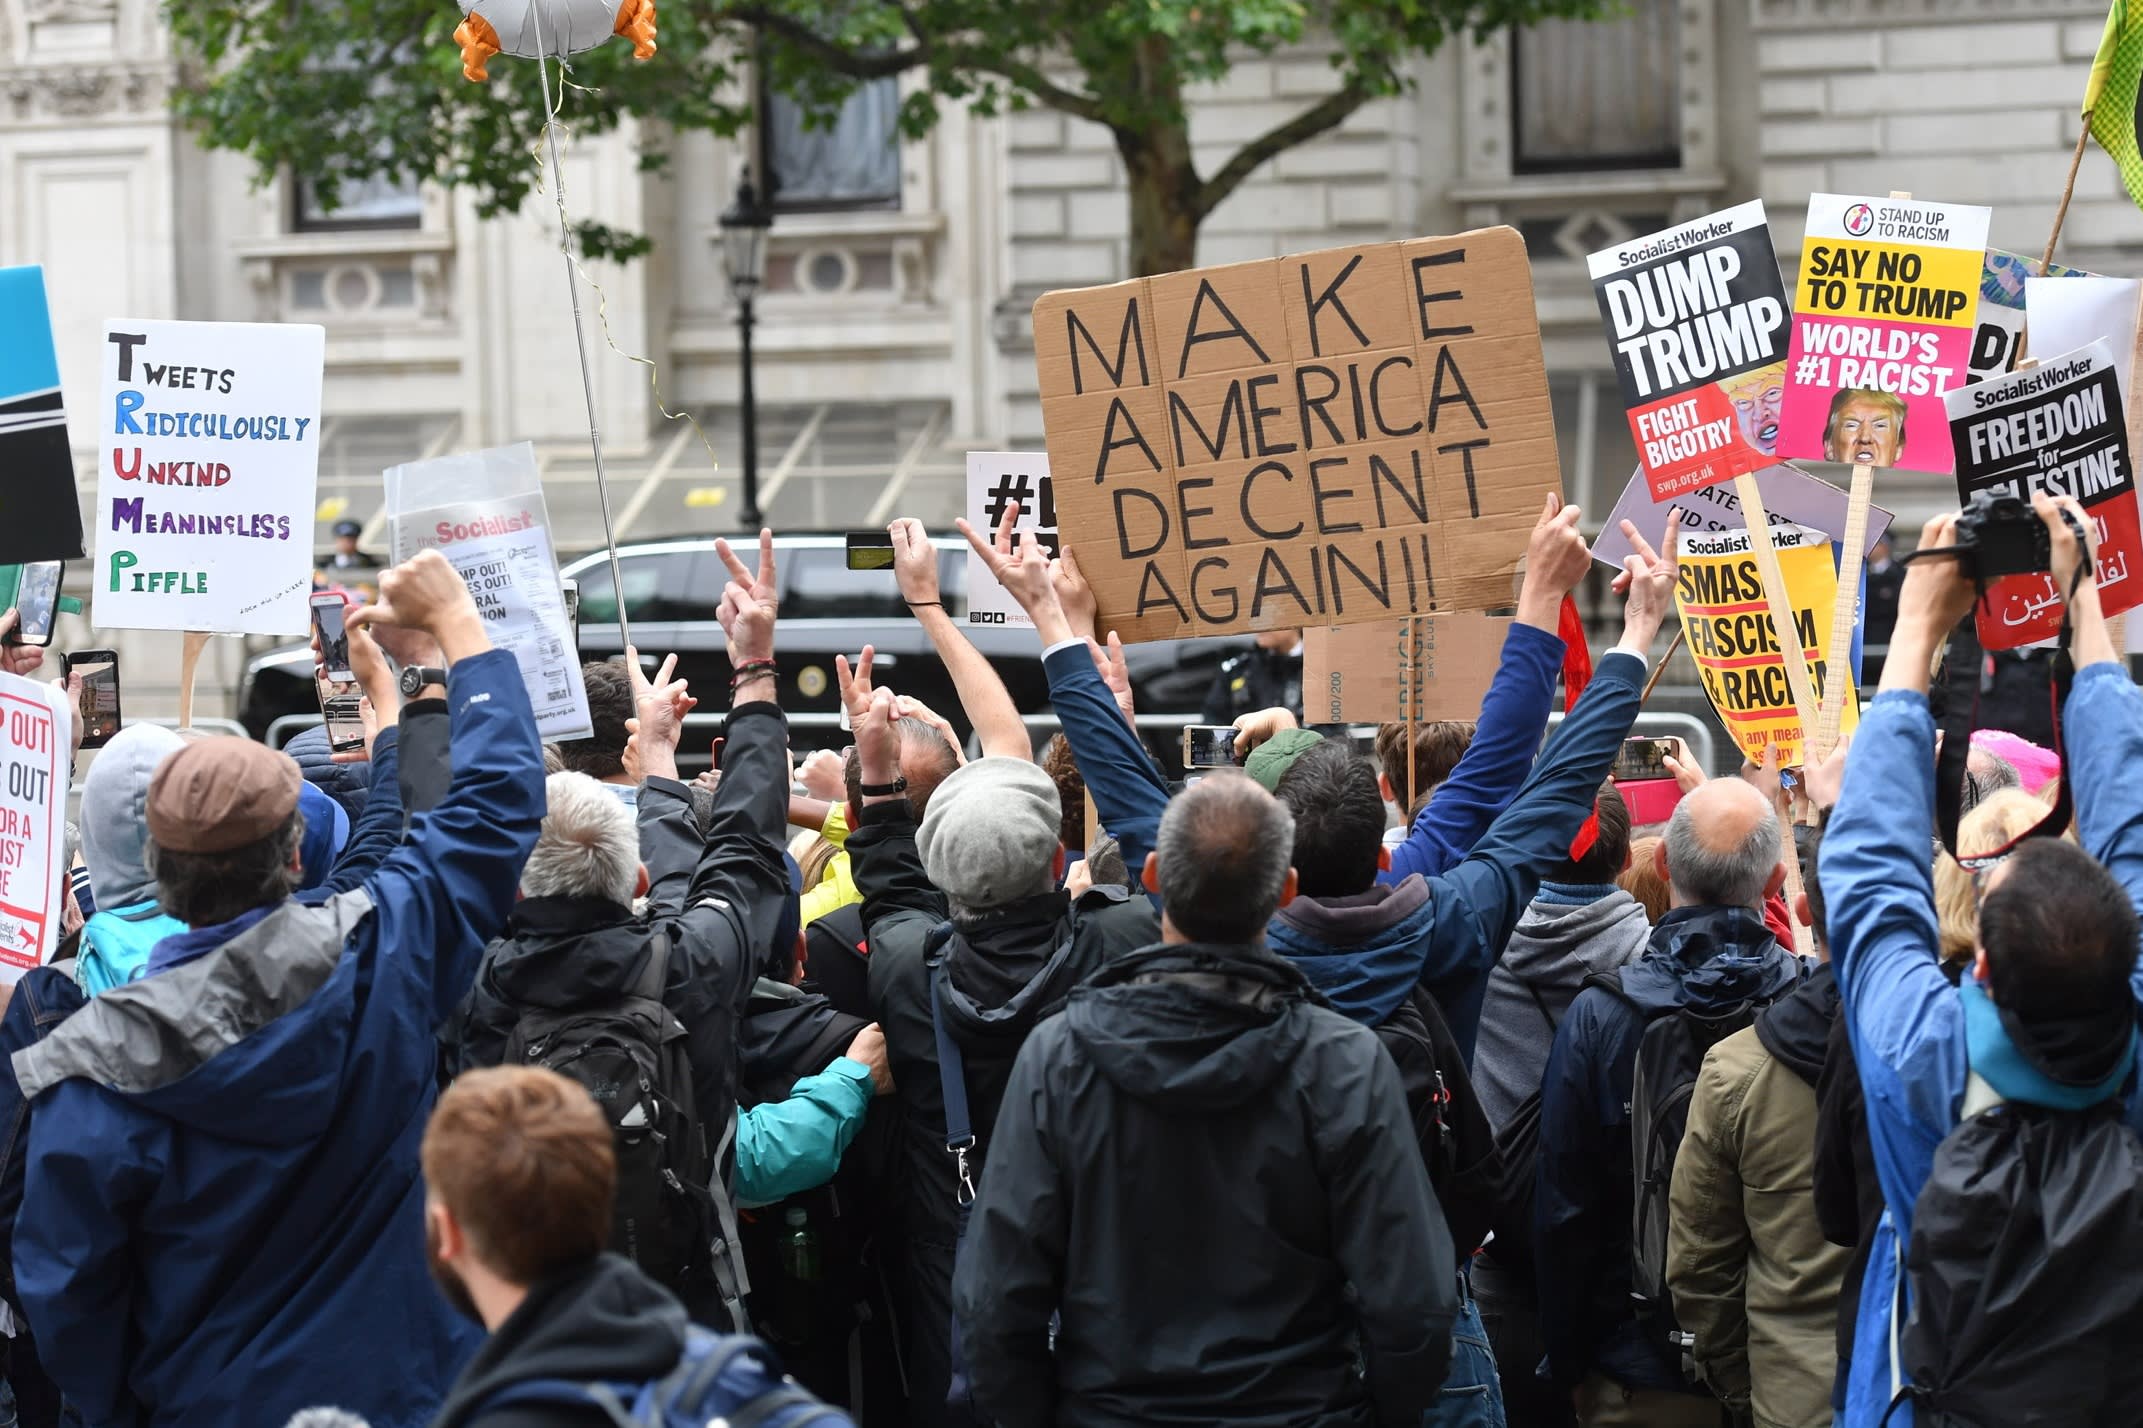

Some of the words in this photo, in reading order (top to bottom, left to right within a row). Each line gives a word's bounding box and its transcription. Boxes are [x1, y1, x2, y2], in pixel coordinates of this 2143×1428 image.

[1877, 222, 1895, 237] TO
[1898, 224, 1950, 243] RACISM
[1879, 207, 1921, 224] STAND
[1925, 211, 1945, 226] UP
[1810, 246, 1869, 279] SAY
[1876, 251, 1922, 283] NO
[1604, 245, 1741, 341] DUMP
[1807, 279, 1847, 310] TO
[1856, 283, 1968, 320] TRUMP
[1067, 249, 1474, 396] MAKE
[1800, 321, 1940, 364] WORLD'S
[109, 333, 236, 394] TWEETS
[1617, 295, 1784, 397] TRUMP
[1795, 357, 1830, 388] #1
[1837, 361, 1953, 399] RACIST
[115, 390, 311, 441] RIDICULOUSLY
[1096, 345, 1488, 485] AMERICA
[1636, 399, 1699, 442] FIGHT
[1968, 383, 2107, 465] FREEDOM
[1644, 415, 1733, 470] BIGOTRY
[2036, 449, 2059, 469] for
[113, 447, 232, 487] UNKIND
[1656, 466, 1715, 494] swp.org.uk
[1970, 444, 2124, 504] ESTINE
[1113, 438, 1491, 560] DECENT
[1694, 486, 1740, 511] ATE
[417, 535, 438, 548] the
[436, 510, 532, 544] Socialist
[1687, 536, 1749, 555] Socialist
[1748, 531, 1802, 549] rker
[110, 550, 208, 595] PIFFLE
[459, 568, 476, 582] MP
[480, 561, 507, 577] OUT!
[468, 580, 481, 594] ES
[484, 574, 512, 590] OUT!
[1136, 534, 1437, 625] AGAIN!!
[1679, 560, 1768, 605] SMAS
[475, 593, 501, 609] RAL
[1704, 667, 1724, 707] &
[11, 710, 49, 754] OUT
[1746, 730, 1768, 747] any
[9, 761, 49, 806] OUT
[22, 814, 32, 841] A
